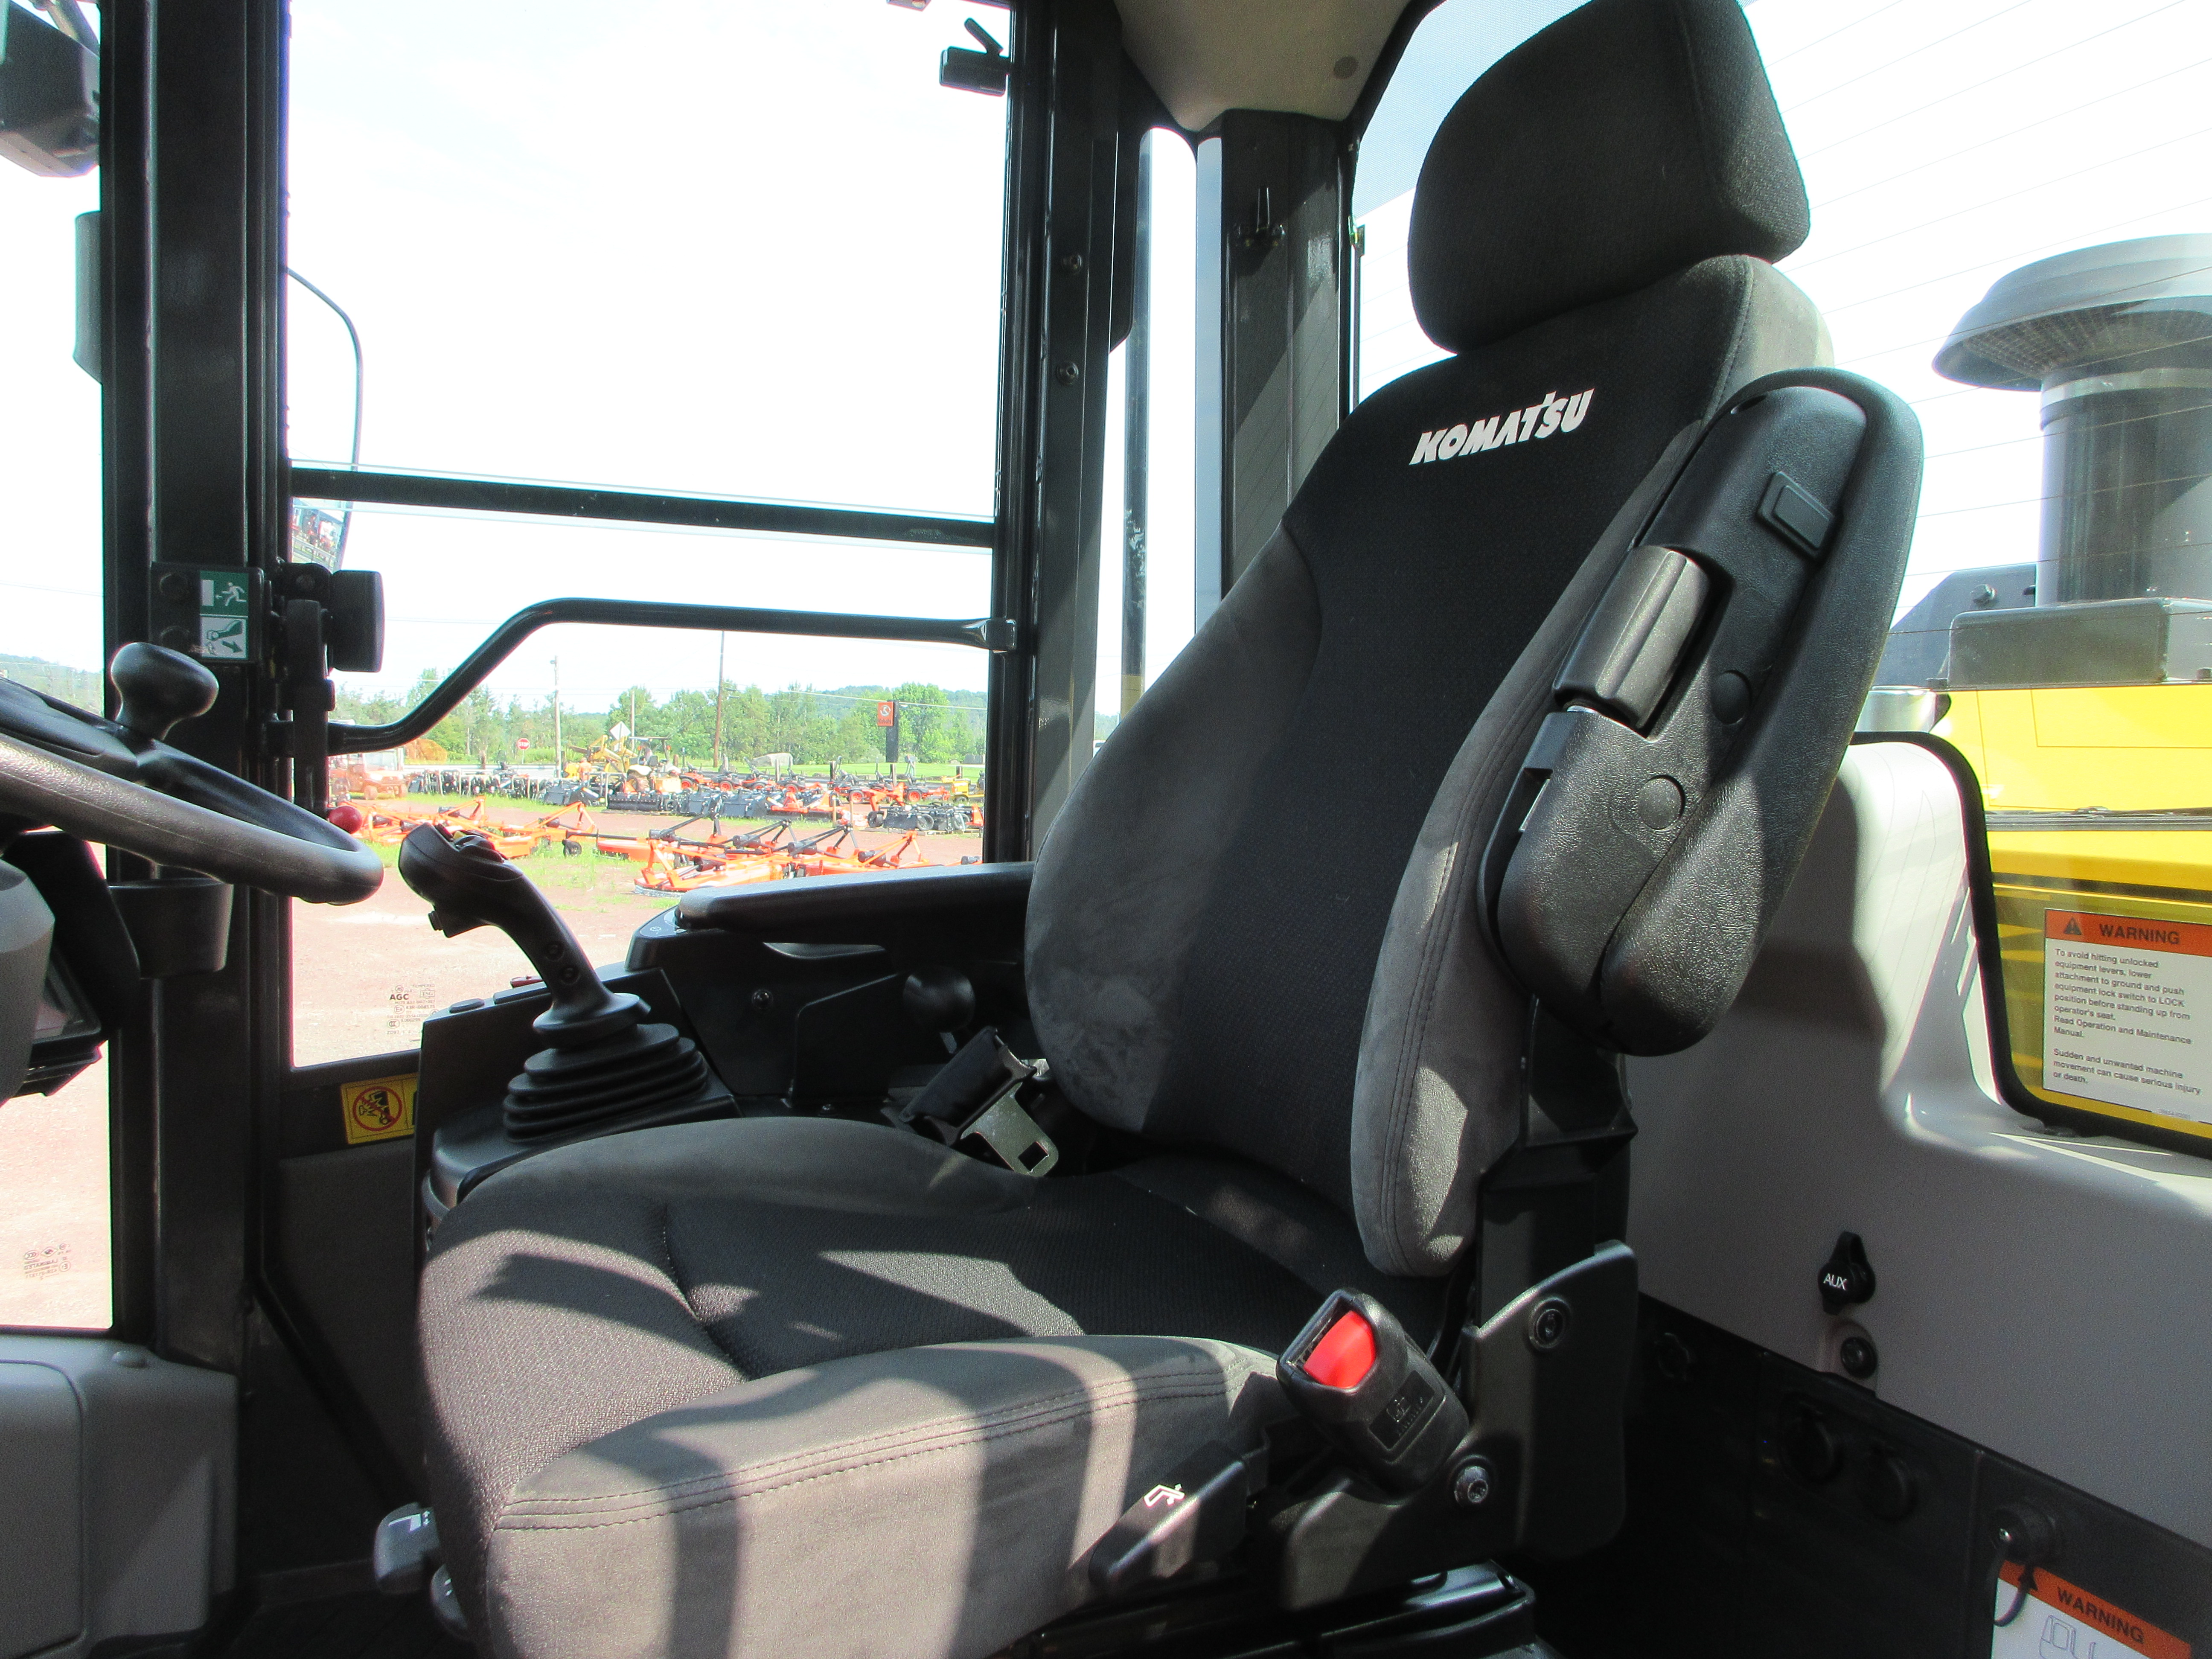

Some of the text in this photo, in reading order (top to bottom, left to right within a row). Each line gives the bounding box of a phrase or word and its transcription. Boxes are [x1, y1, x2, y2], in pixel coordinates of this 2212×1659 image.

[1409, 388, 1595, 465] KOMATSU
[2099, 923, 2180, 945] WARNING
[2055, 961, 2152, 979] equipment levers, lower
[2067, 951, 2089, 959] avoid
[2091, 953, 2117, 964] hitting
[2119, 958, 2159, 968] unlocked
[2054, 983, 2096, 994] equipment
[2098, 988, 2116, 998] lock
[2118, 992, 2145, 1001] switch
[2159, 996, 2185, 1007] LOCK
[2055, 972, 2099, 984] attachment
[2112, 980, 2142, 990] ground
[2162, 987, 2184, 995] push
[2054, 994, 2087, 1004] position
[2089, 998, 2115, 1008] before
[2117, 1004, 2154, 1016] standing
[2170, 1010, 2191, 1020] from
[2054, 1005, 2116, 1021] operator's seat.
[2054, 1015, 2074, 1025] Read
[2076, 1019, 2116, 1032] Operation
[2136, 1028, 2192, 1044] Maintenance
[2054, 1026, 2084, 1038] Manual.
[2053, 1048, 2183, 1079] Sudden and unwanted machine
[2053, 1060, 2201, 1095] movement can cause serious injury
[2064, 1073, 2088, 1083] death.
[1823, 1273, 1847, 1290] AUX
[2057, 1587, 2145, 1644] WARNING
